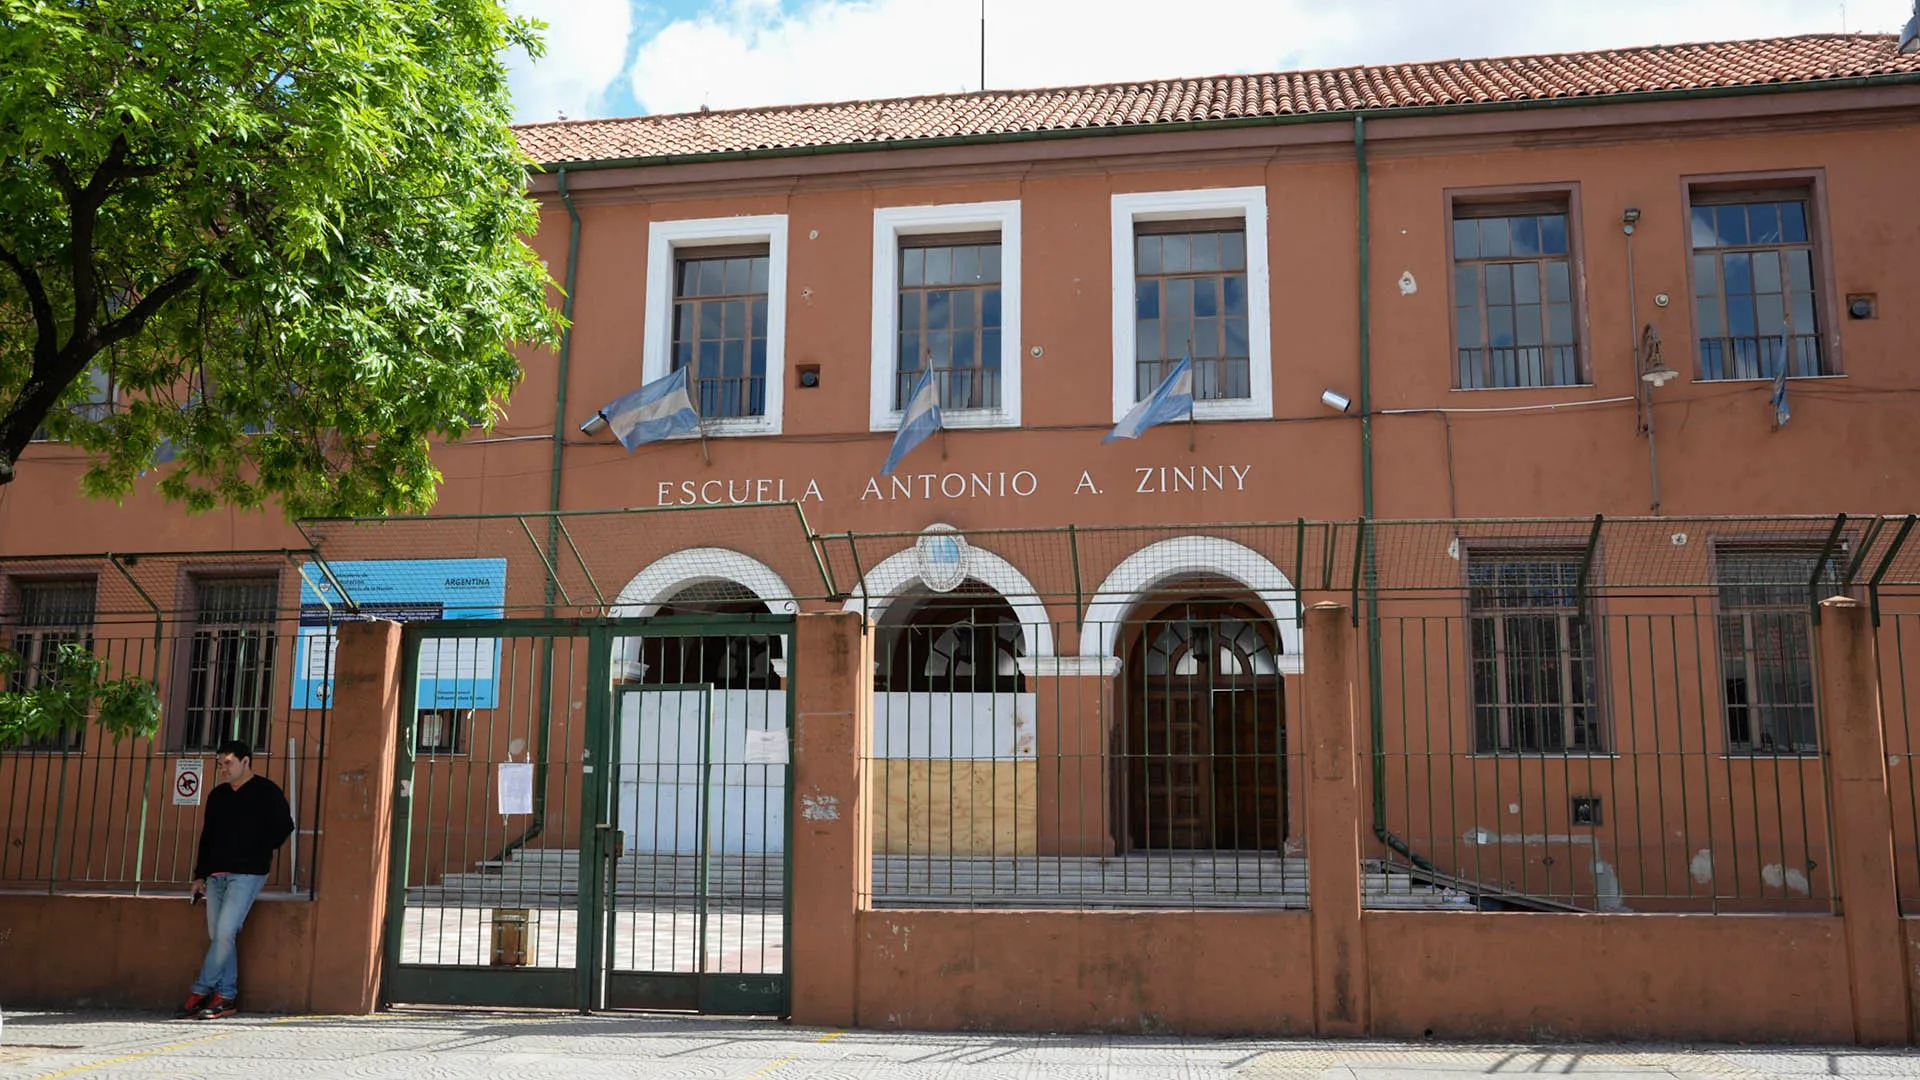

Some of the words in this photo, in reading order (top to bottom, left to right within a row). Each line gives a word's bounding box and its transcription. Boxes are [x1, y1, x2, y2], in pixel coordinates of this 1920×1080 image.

[657, 478, 824, 506] ESCUELA
[860, 470, 1038, 500] ANTONIO
[1073, 470, 1104, 494] A.
[1135, 465, 1252, 493] ZINNY
[444, 578, 490, 586] ARGENTINA
